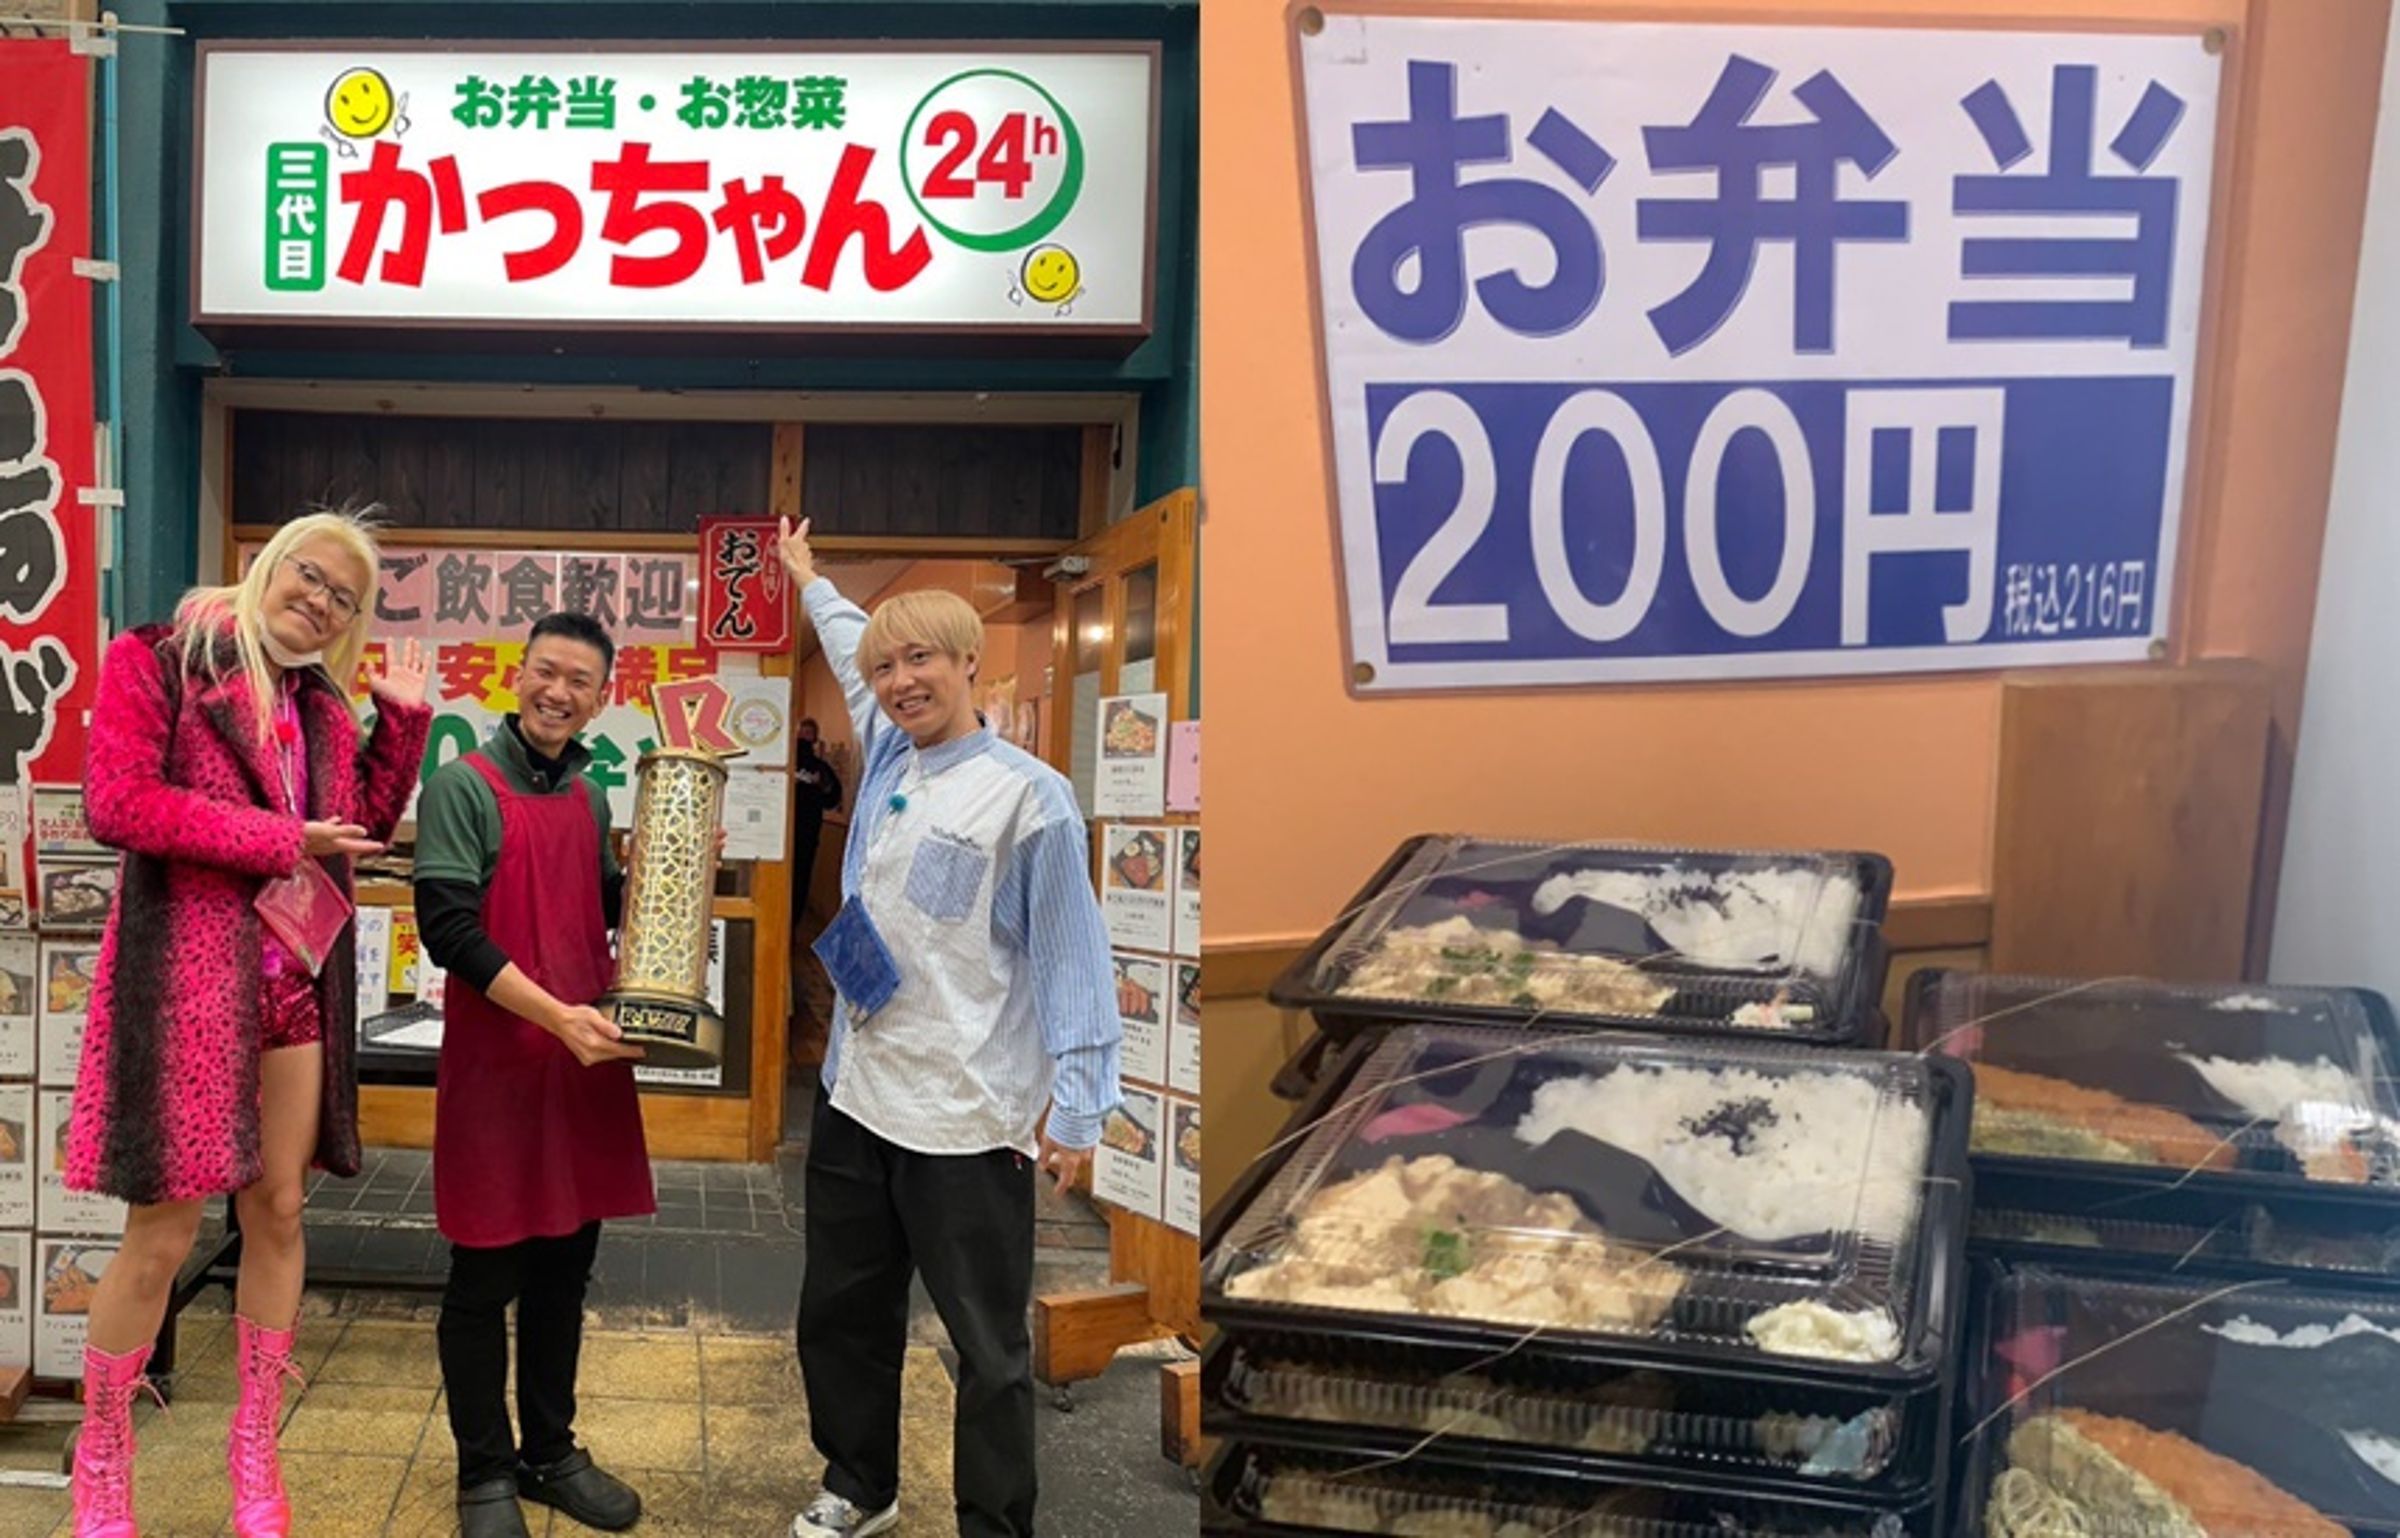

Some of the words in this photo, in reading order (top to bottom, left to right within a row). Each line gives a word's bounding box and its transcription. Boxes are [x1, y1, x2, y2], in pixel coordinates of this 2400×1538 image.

[451, 73, 848, 132] お弁当・お惣菜
[922, 110, 1059, 200] 24h
[277, 151, 317, 280] 三代目
[336, 141, 934, 292] かっちゃん
[1351, 53, 2187, 358] お弁当
[1375, 387, 2006, 646] 200円
[374, 553, 684, 630] ご飲食歓迎
[716, 529, 762, 638] おでん
[2004, 561, 2146, 634] 税込216円
